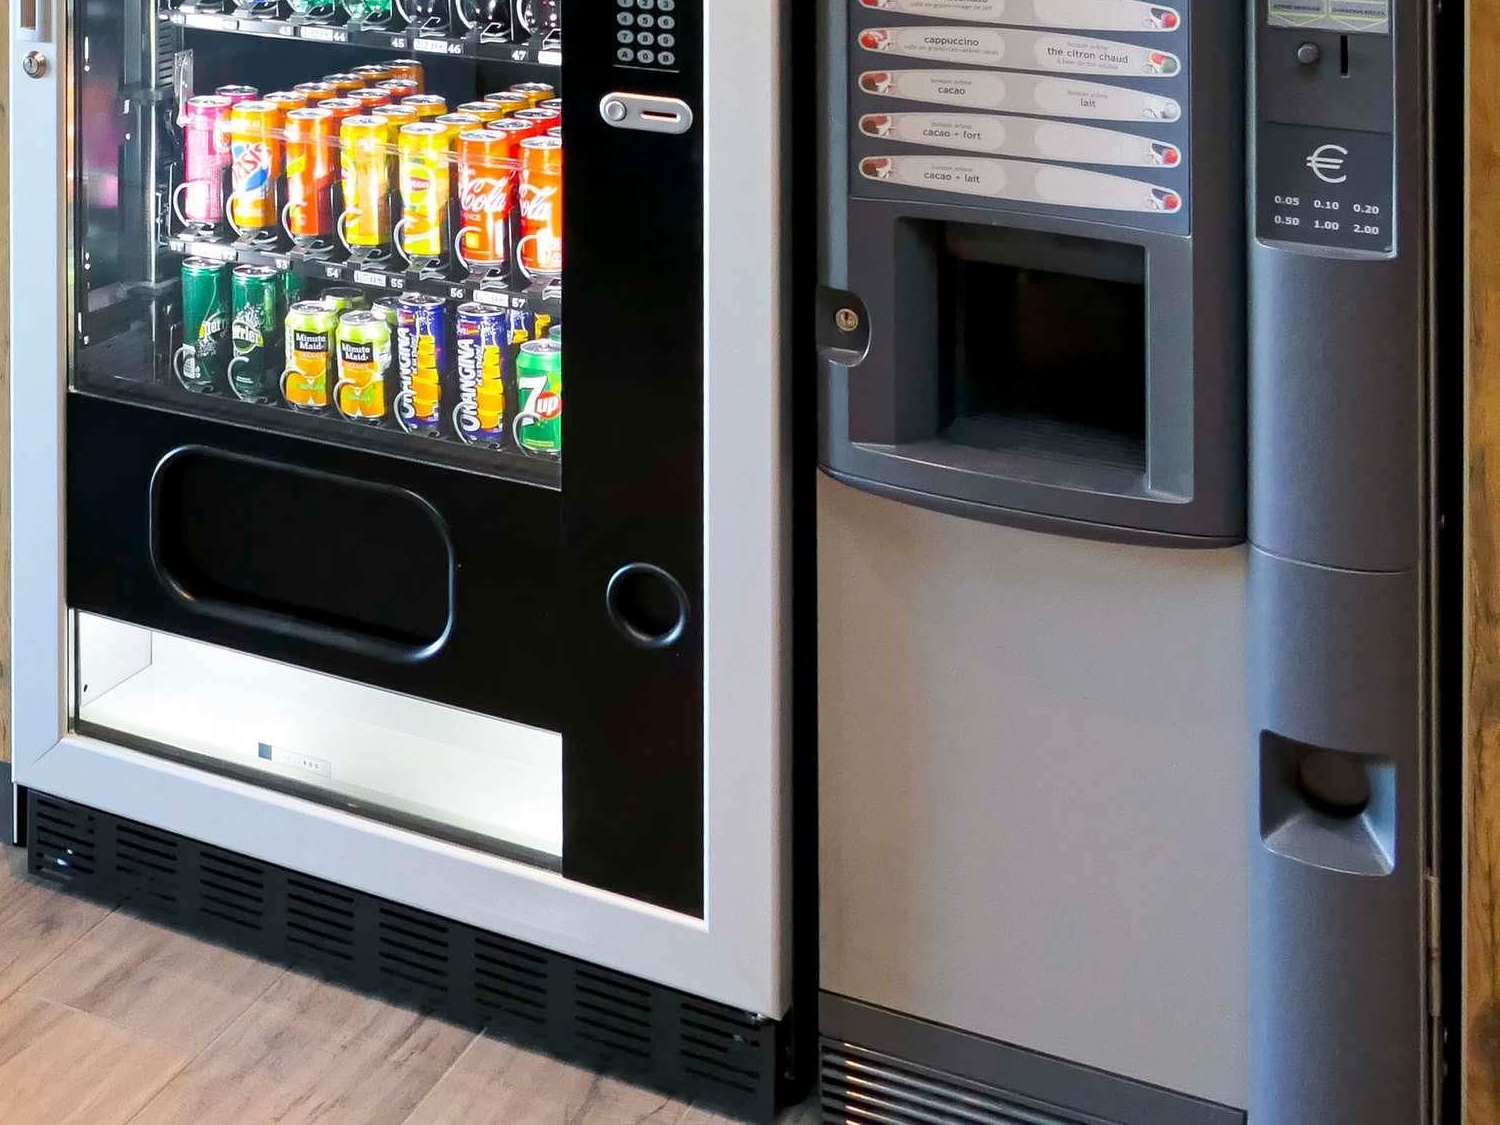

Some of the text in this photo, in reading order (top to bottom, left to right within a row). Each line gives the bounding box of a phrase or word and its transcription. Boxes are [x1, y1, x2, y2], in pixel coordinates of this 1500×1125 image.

[391, 37, 405, 48] 45
[923, 36, 980, 47] cappuccino
[447, 43, 462, 55] 46
[511, 50, 527, 61] 47
[1066, 49, 1095, 59] citron
[1099, 54, 1129, 64] chaud
[938, 86, 966, 95] cacao
[1080, 98, 1096, 108] lait
[922, 129, 951, 138] cacao
[963, 130, 981, 140] fort
[924, 172, 952, 181] cacao
[964, 174, 981, 183] lait
[1274, 195, 1380, 215] 0.05 0.10 0.20
[1274, 215, 1380, 235] 0.50 1.00 2.00
[326, 267, 339, 278] 54
[390, 278, 404, 289] 55
[450, 288, 464, 299] 56
[511, 298, 526, 309] 57
[296, 333, 327, 342] Minute
[299, 341, 322, 350] Maid
[342, 343, 370, 353] Minute
[345, 352, 366, 361] Maid
